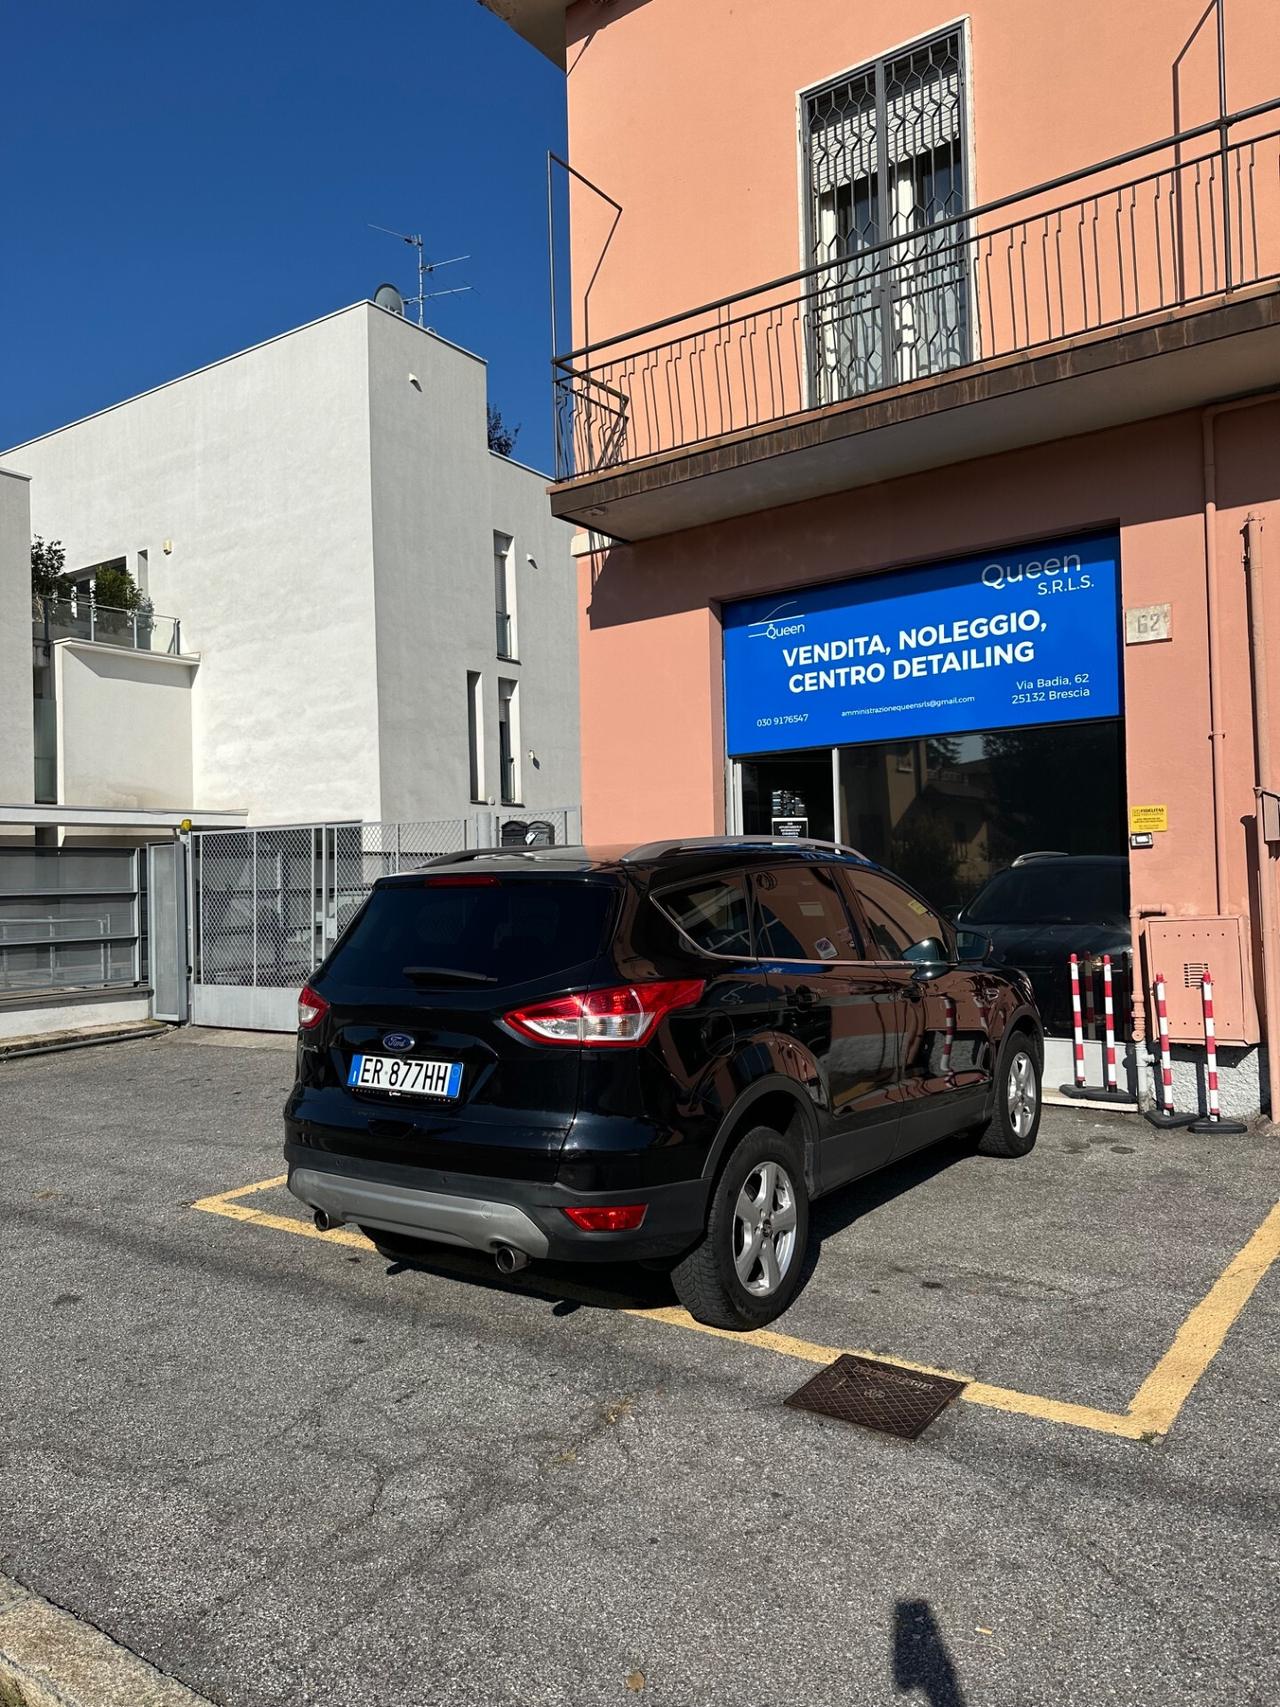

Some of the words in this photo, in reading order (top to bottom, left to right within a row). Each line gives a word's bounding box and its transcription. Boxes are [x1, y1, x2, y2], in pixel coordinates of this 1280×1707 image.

[981, 553, 1081, 590] Queen
[1037, 574, 1095, 596] S.R.L.S.
[766, 622, 805, 640] Queen
[1137, 613, 1161, 634] 62
[782, 634, 891, 667] VENDITA,
[898, 608, 1047, 651] NOLEGGIO,
[788, 662, 885, 693] CENTRO
[893, 640, 1035, 680] DETAILING
[1016, 680, 1034, 690] Via
[1037, 676, 1072, 689] Badia,
[1074, 673, 1089, 684] 62
[841, 695, 975, 717] amministrazionequeensrls@gmail.com
[1011, 692, 1046, 705] 25132
[1048, 687, 1091, 700] Brescia
[756, 717, 772, 728] 030
[773, 713, 809, 726] 9176547
[388, 1035, 407, 1048] Ford
[360, 1057, 384, 1085] ER
[388, 1060, 449, 1092] 877HH
